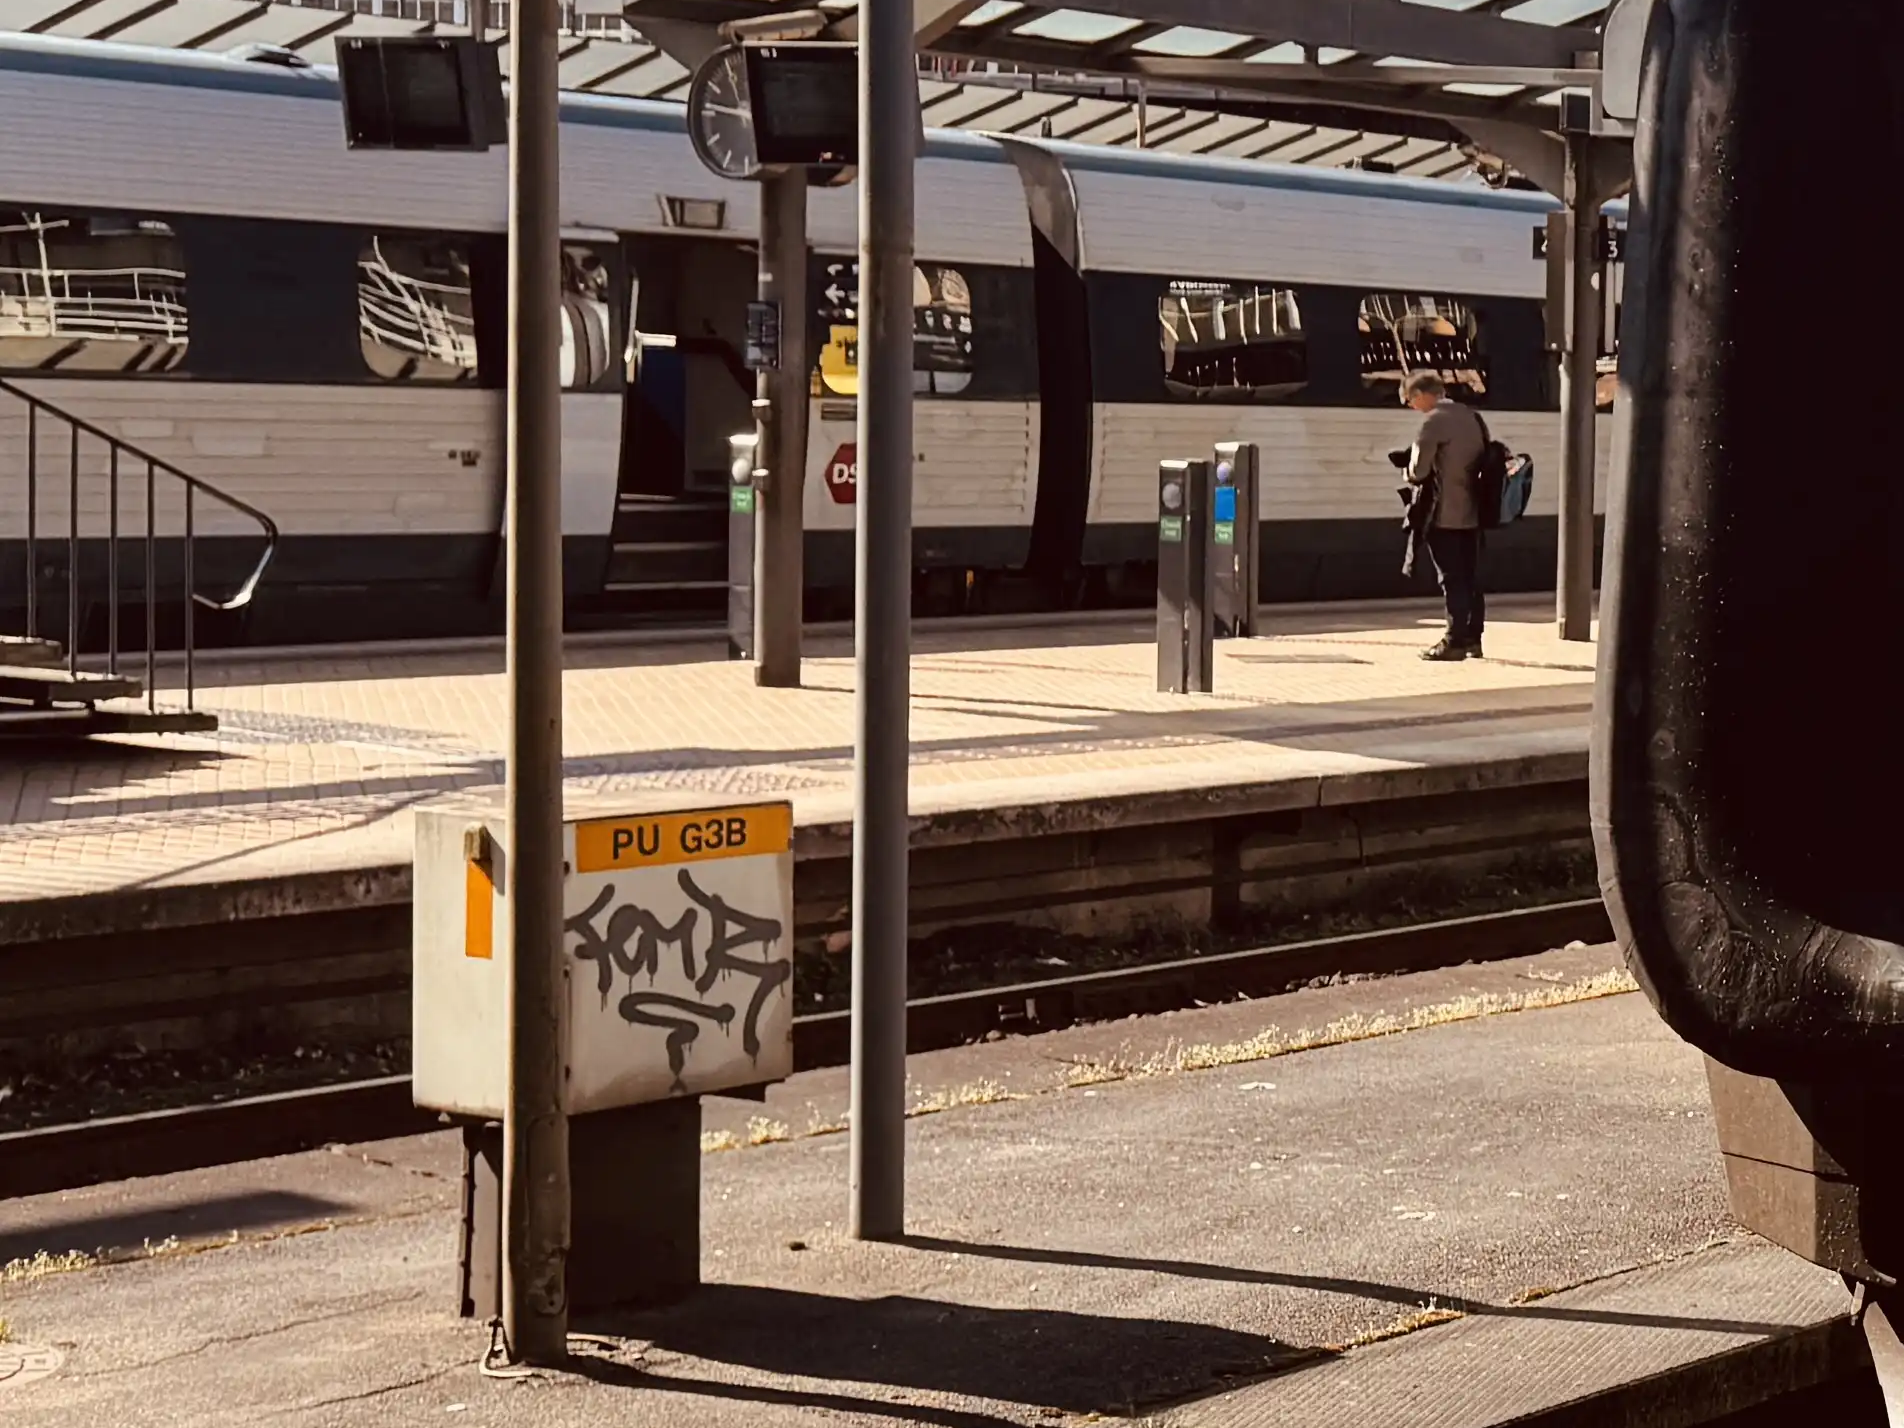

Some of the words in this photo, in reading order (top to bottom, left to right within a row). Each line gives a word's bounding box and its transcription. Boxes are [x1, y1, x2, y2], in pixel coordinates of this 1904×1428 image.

[1607, 240, 1618, 259] 3
[832, 463, 857, 484] DS
[612, 825, 660, 860] PU
[680, 818, 747, 854] G3B
